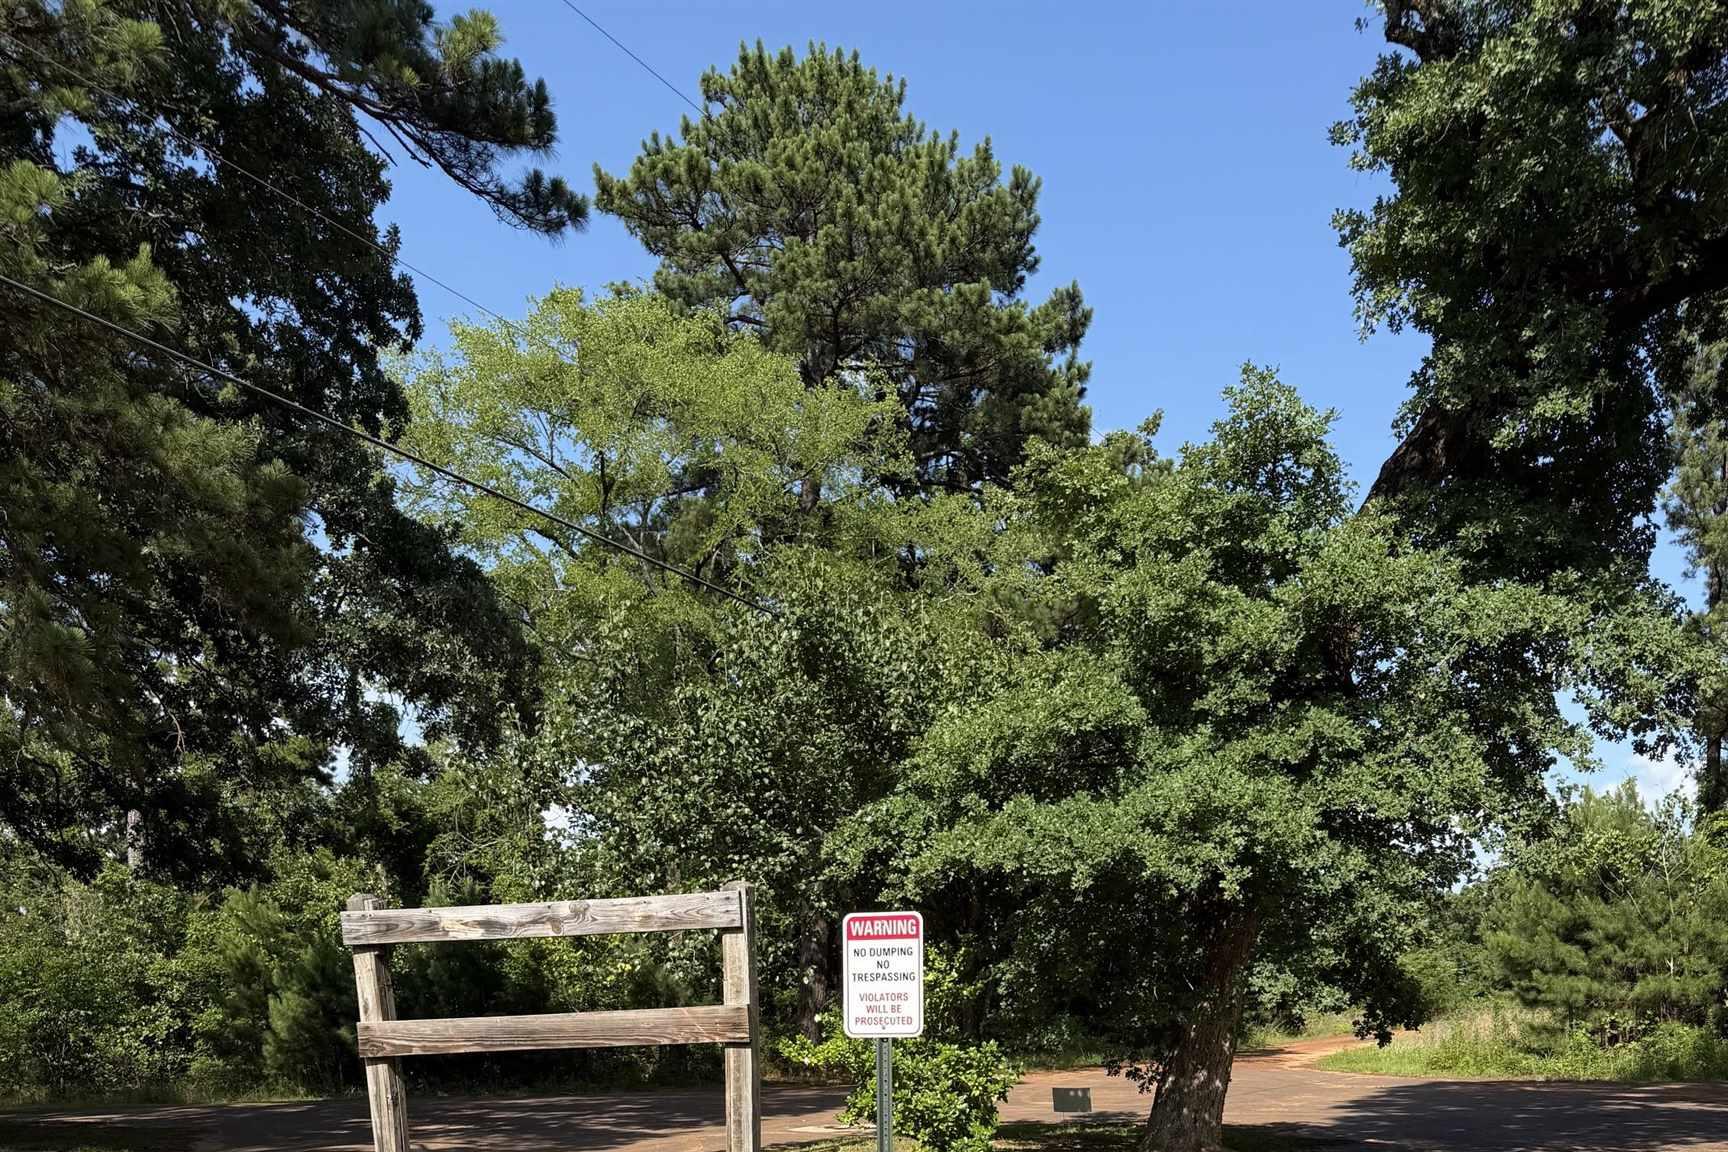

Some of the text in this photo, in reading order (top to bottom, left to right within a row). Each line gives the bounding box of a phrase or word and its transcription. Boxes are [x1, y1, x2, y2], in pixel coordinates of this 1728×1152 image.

[850, 919, 917, 937] WARNING
[853, 947, 913, 958] NO DUMPING
[876, 960, 890, 969] NO
[852, 972, 916, 982] TRESPASSING
[859, 992, 909, 1002] VIOLATORS
[866, 1004, 902, 1014] WILL BE
[855, 1016, 913, 1026] PROSECUTED
